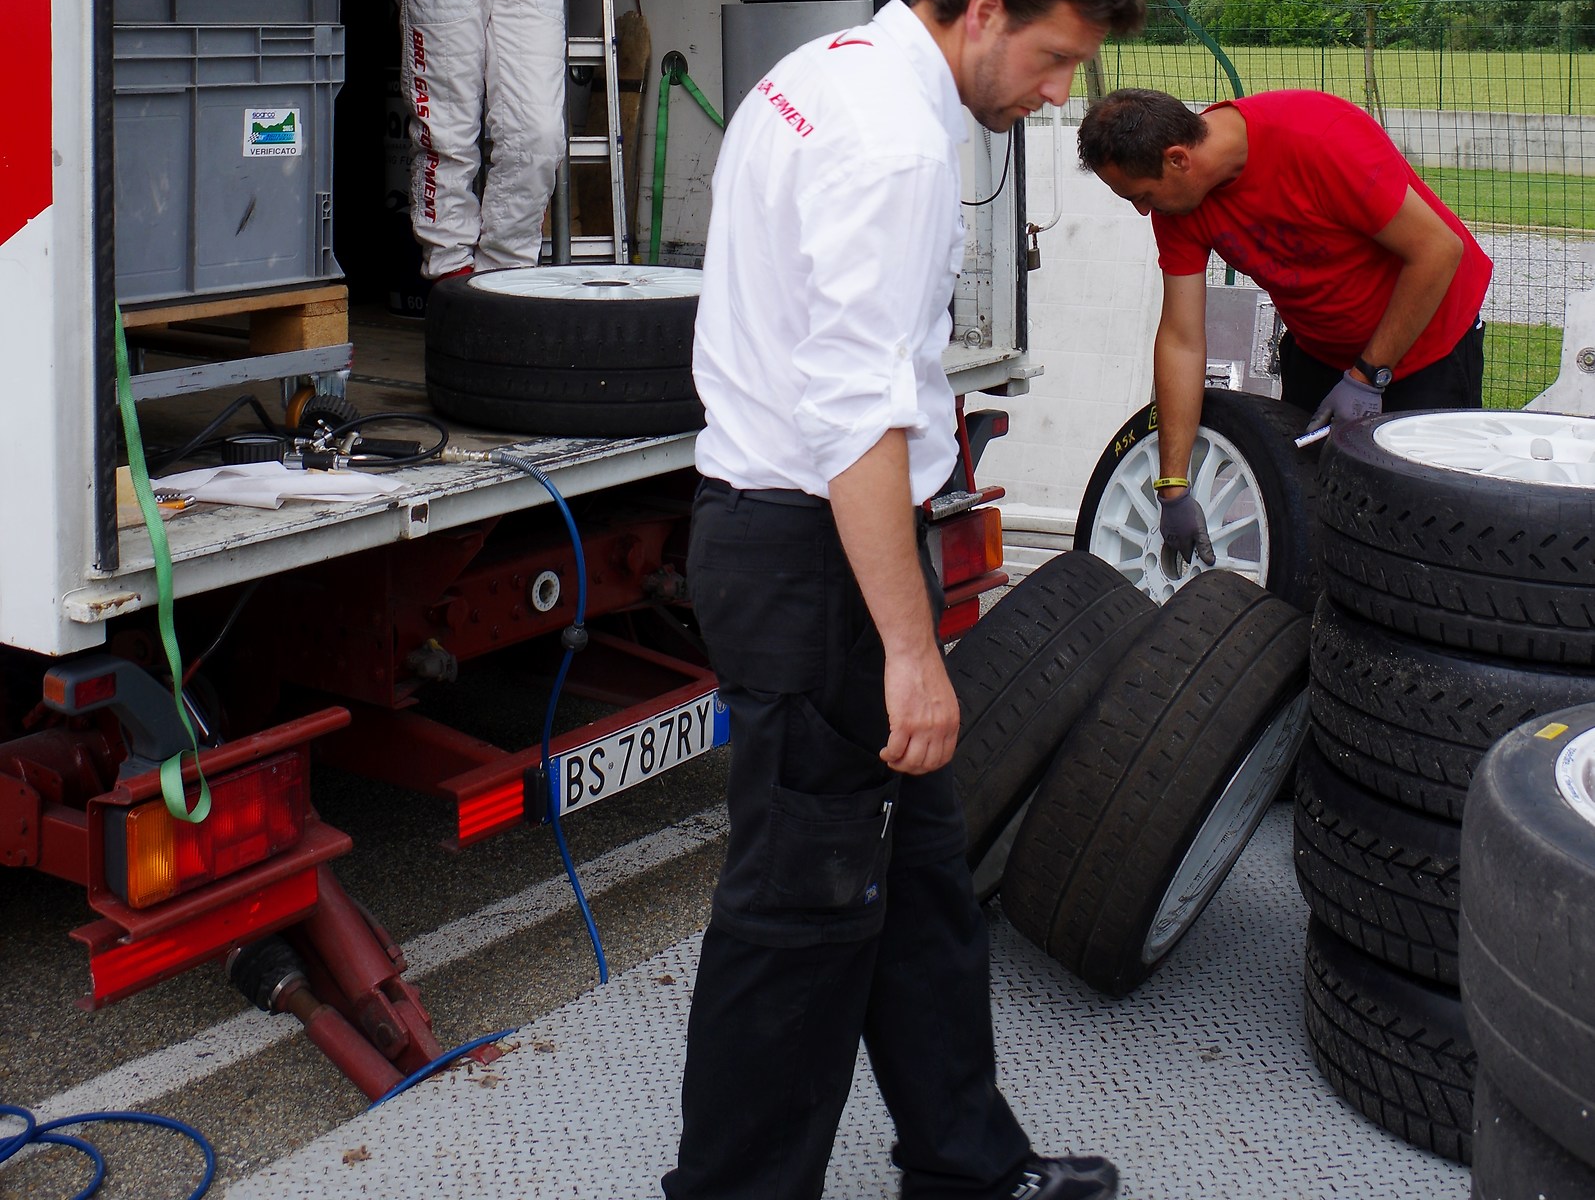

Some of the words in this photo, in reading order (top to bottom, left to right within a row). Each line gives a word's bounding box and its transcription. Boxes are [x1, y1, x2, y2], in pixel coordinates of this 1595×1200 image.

[412, 27, 426, 73] BRC
[413, 76, 430, 118] GAS
[250, 147, 297, 155] VERIFICATO
[566, 746, 606, 808] BS
[618, 700, 710, 787] 787RY
